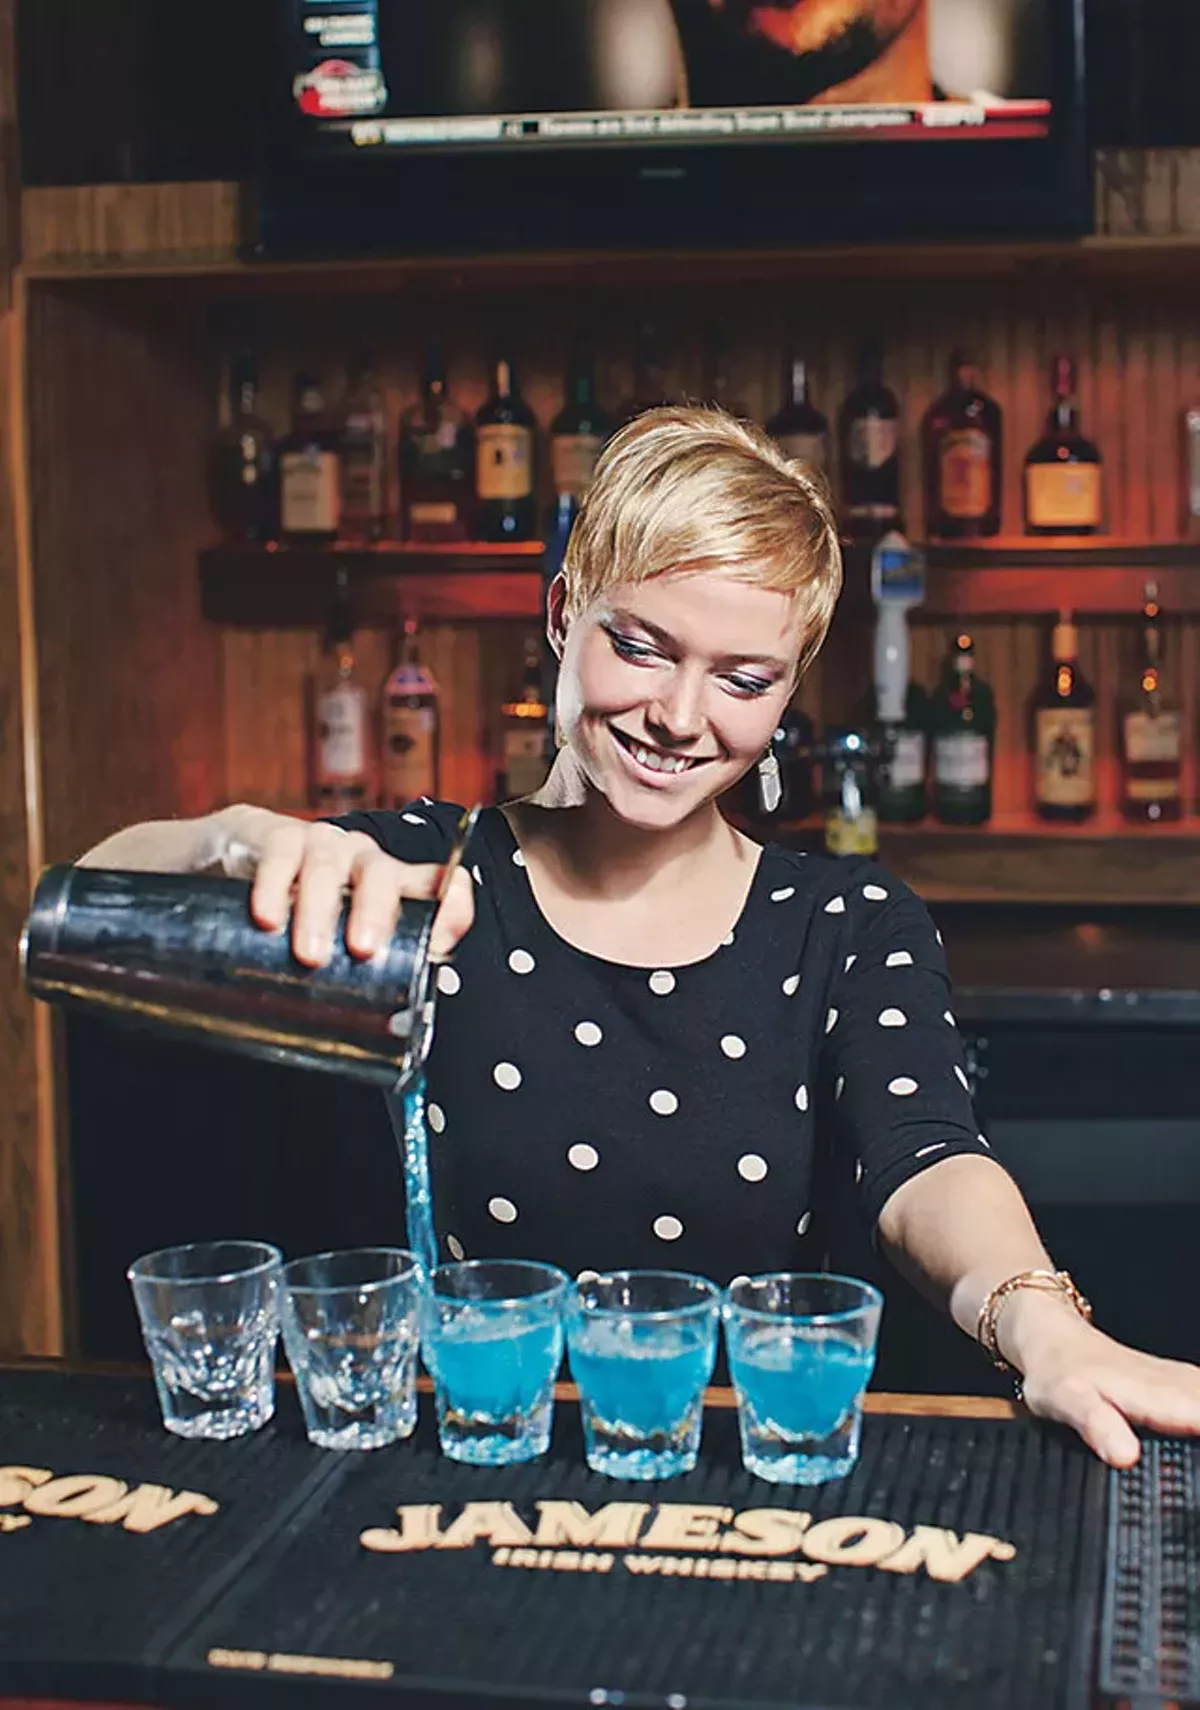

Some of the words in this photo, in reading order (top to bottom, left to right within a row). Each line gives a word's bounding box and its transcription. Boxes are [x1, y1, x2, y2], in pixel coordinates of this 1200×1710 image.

[359, 1501, 1016, 1583] JAMESON
[492, 1547, 615, 1573] IRISH
[623, 1553, 828, 1582] WHISKEY
